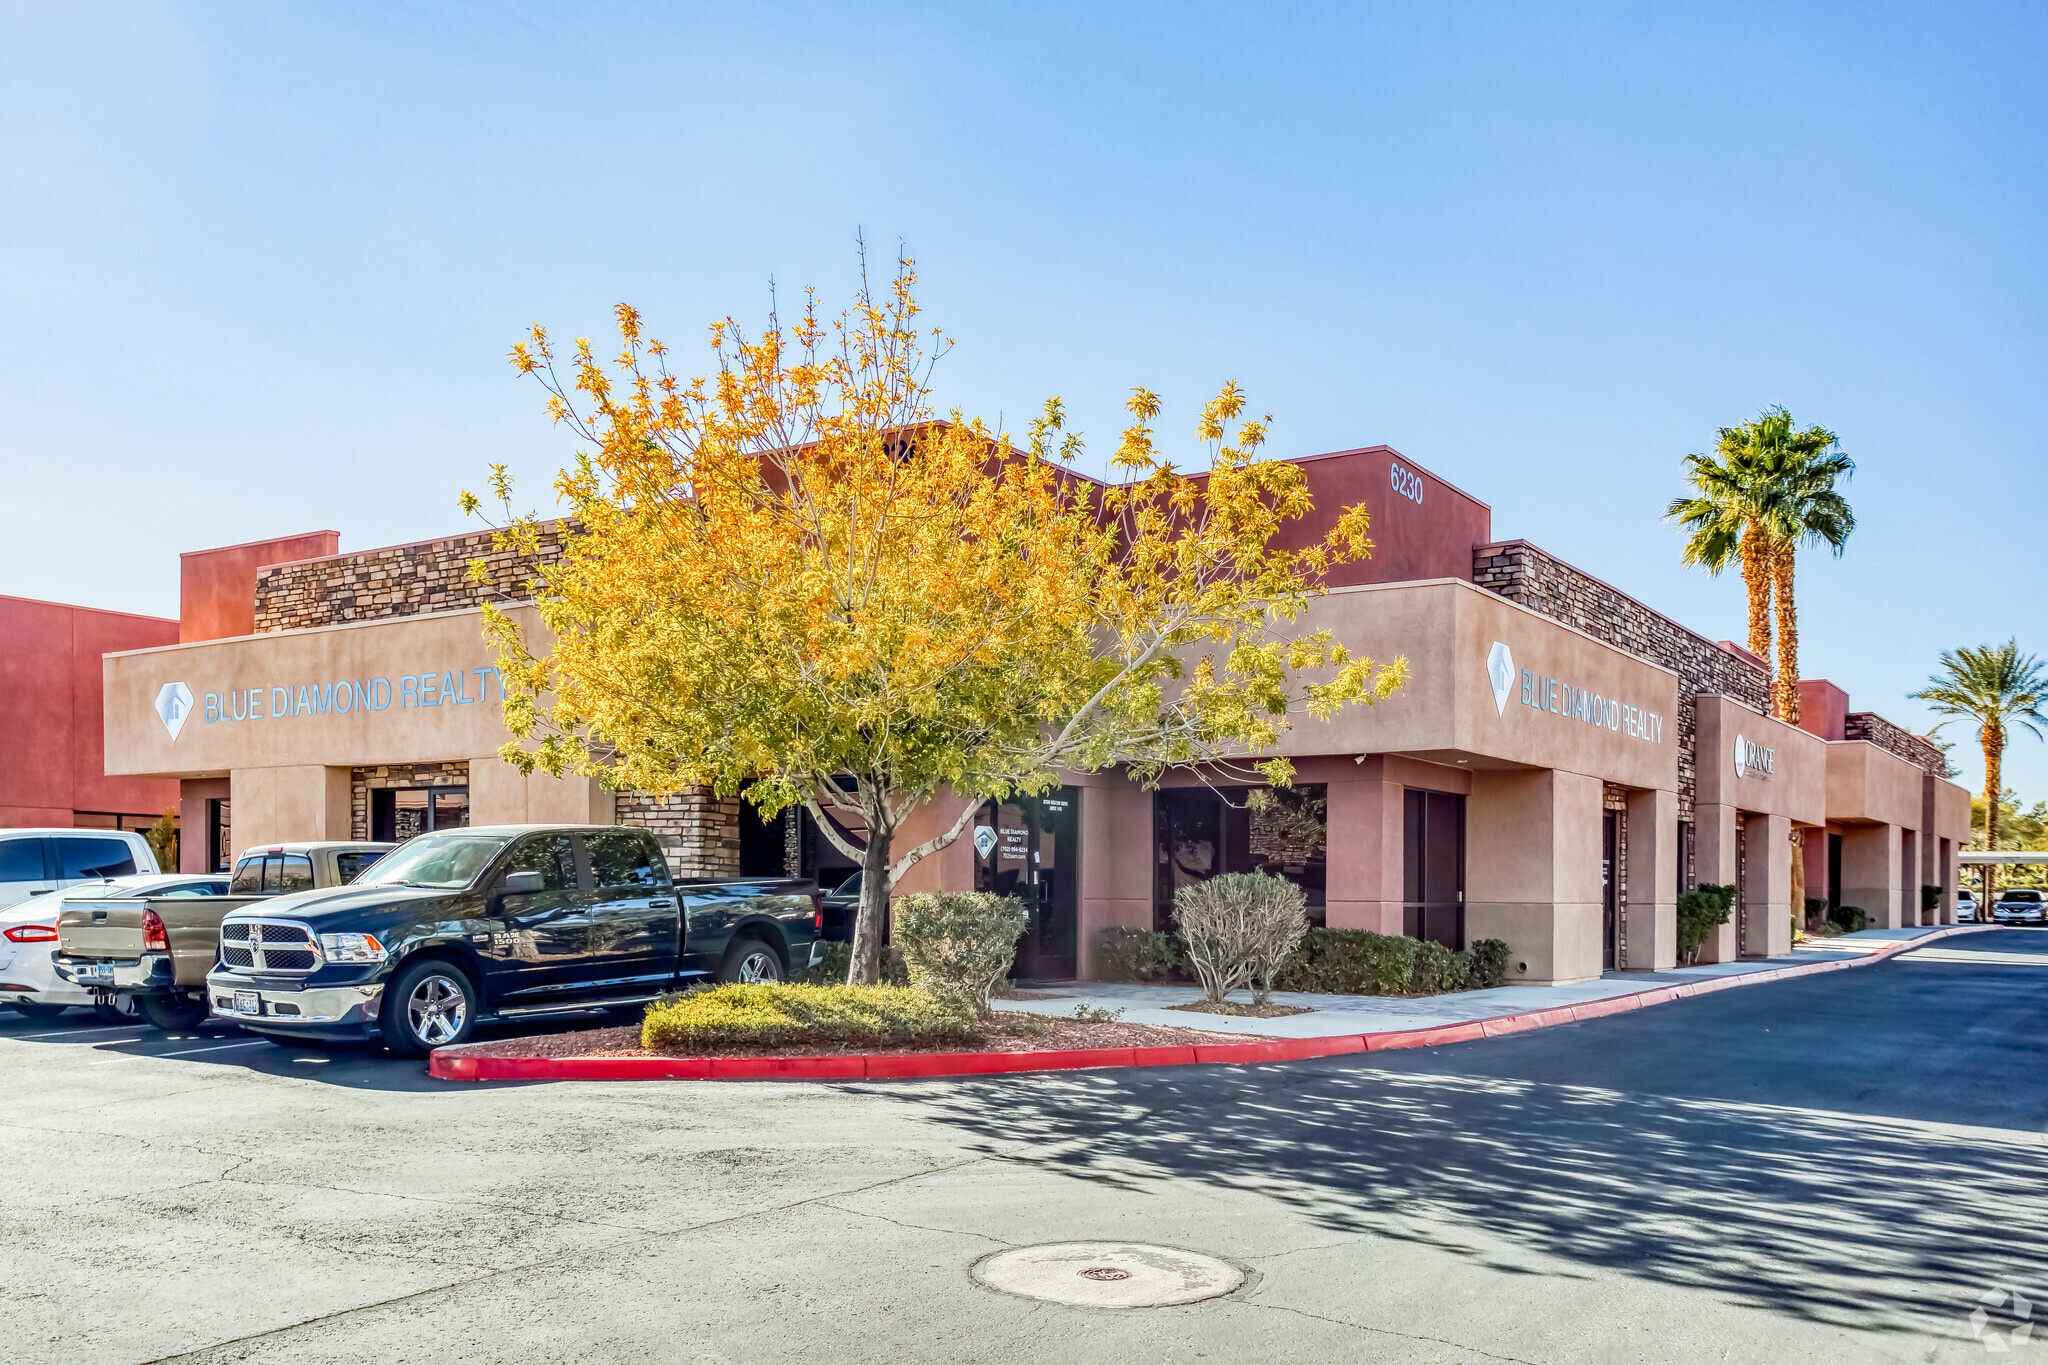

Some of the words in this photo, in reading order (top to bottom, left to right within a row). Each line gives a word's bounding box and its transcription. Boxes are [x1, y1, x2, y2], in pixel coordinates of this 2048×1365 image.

[1390, 462, 1423, 505] 6230
[204, 688, 264, 723] BLUE
[271, 677, 392, 719] DIAMOND
[1521, 668, 1558, 714] BLUE
[1561, 682, 1620, 732] DIAMOND
[1621, 703, 1663, 744] REALTY
[1745, 740, 1774, 774] ORANGE
